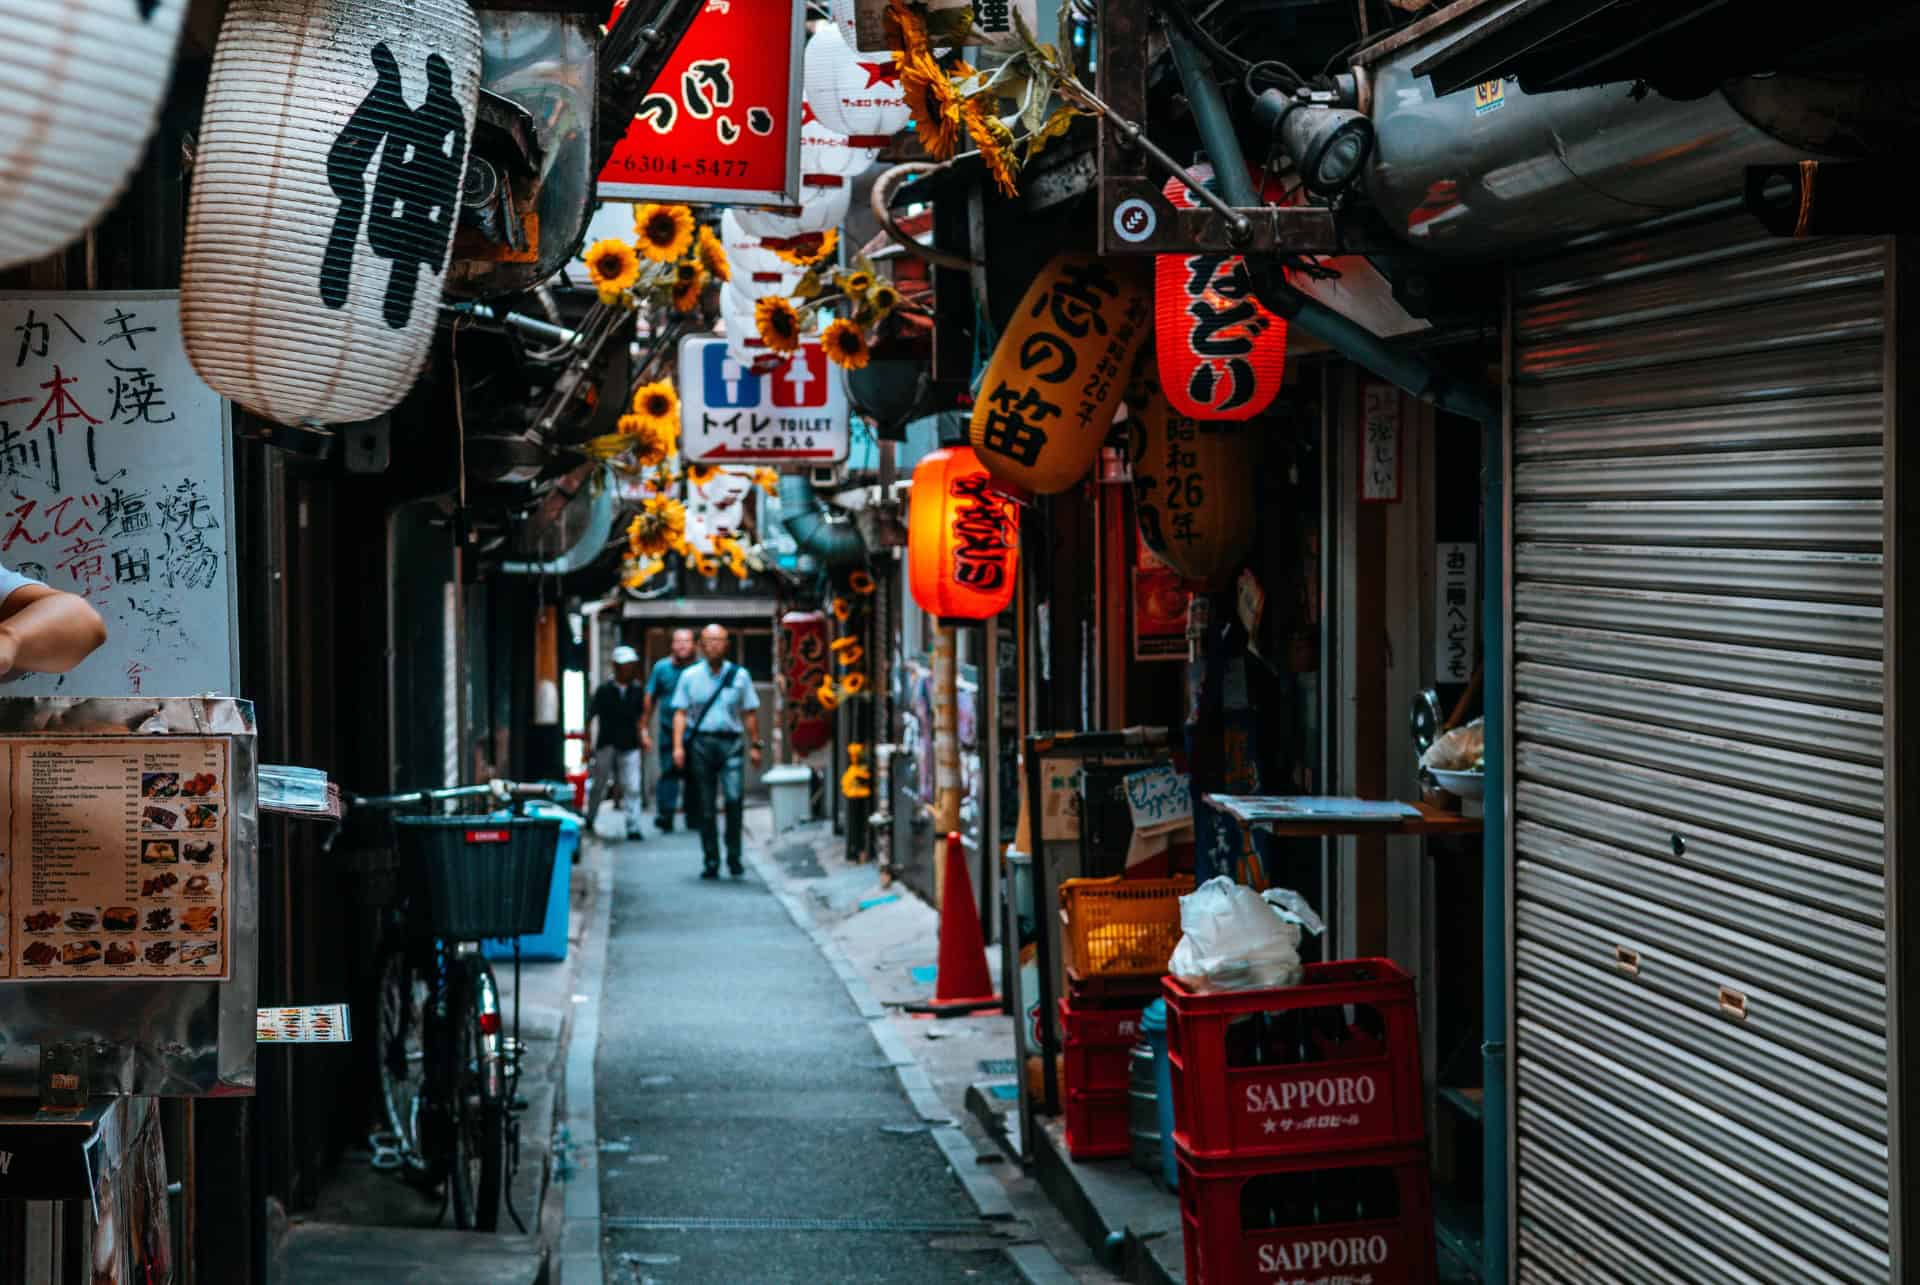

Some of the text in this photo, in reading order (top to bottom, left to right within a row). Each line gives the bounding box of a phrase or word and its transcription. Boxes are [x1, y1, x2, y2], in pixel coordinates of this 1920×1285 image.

[703, 412, 833, 435] トイレ TOILET
[1245, 1075, 1376, 1113] SAPPORO
[1257, 1235, 1388, 1274] SAPPORO
